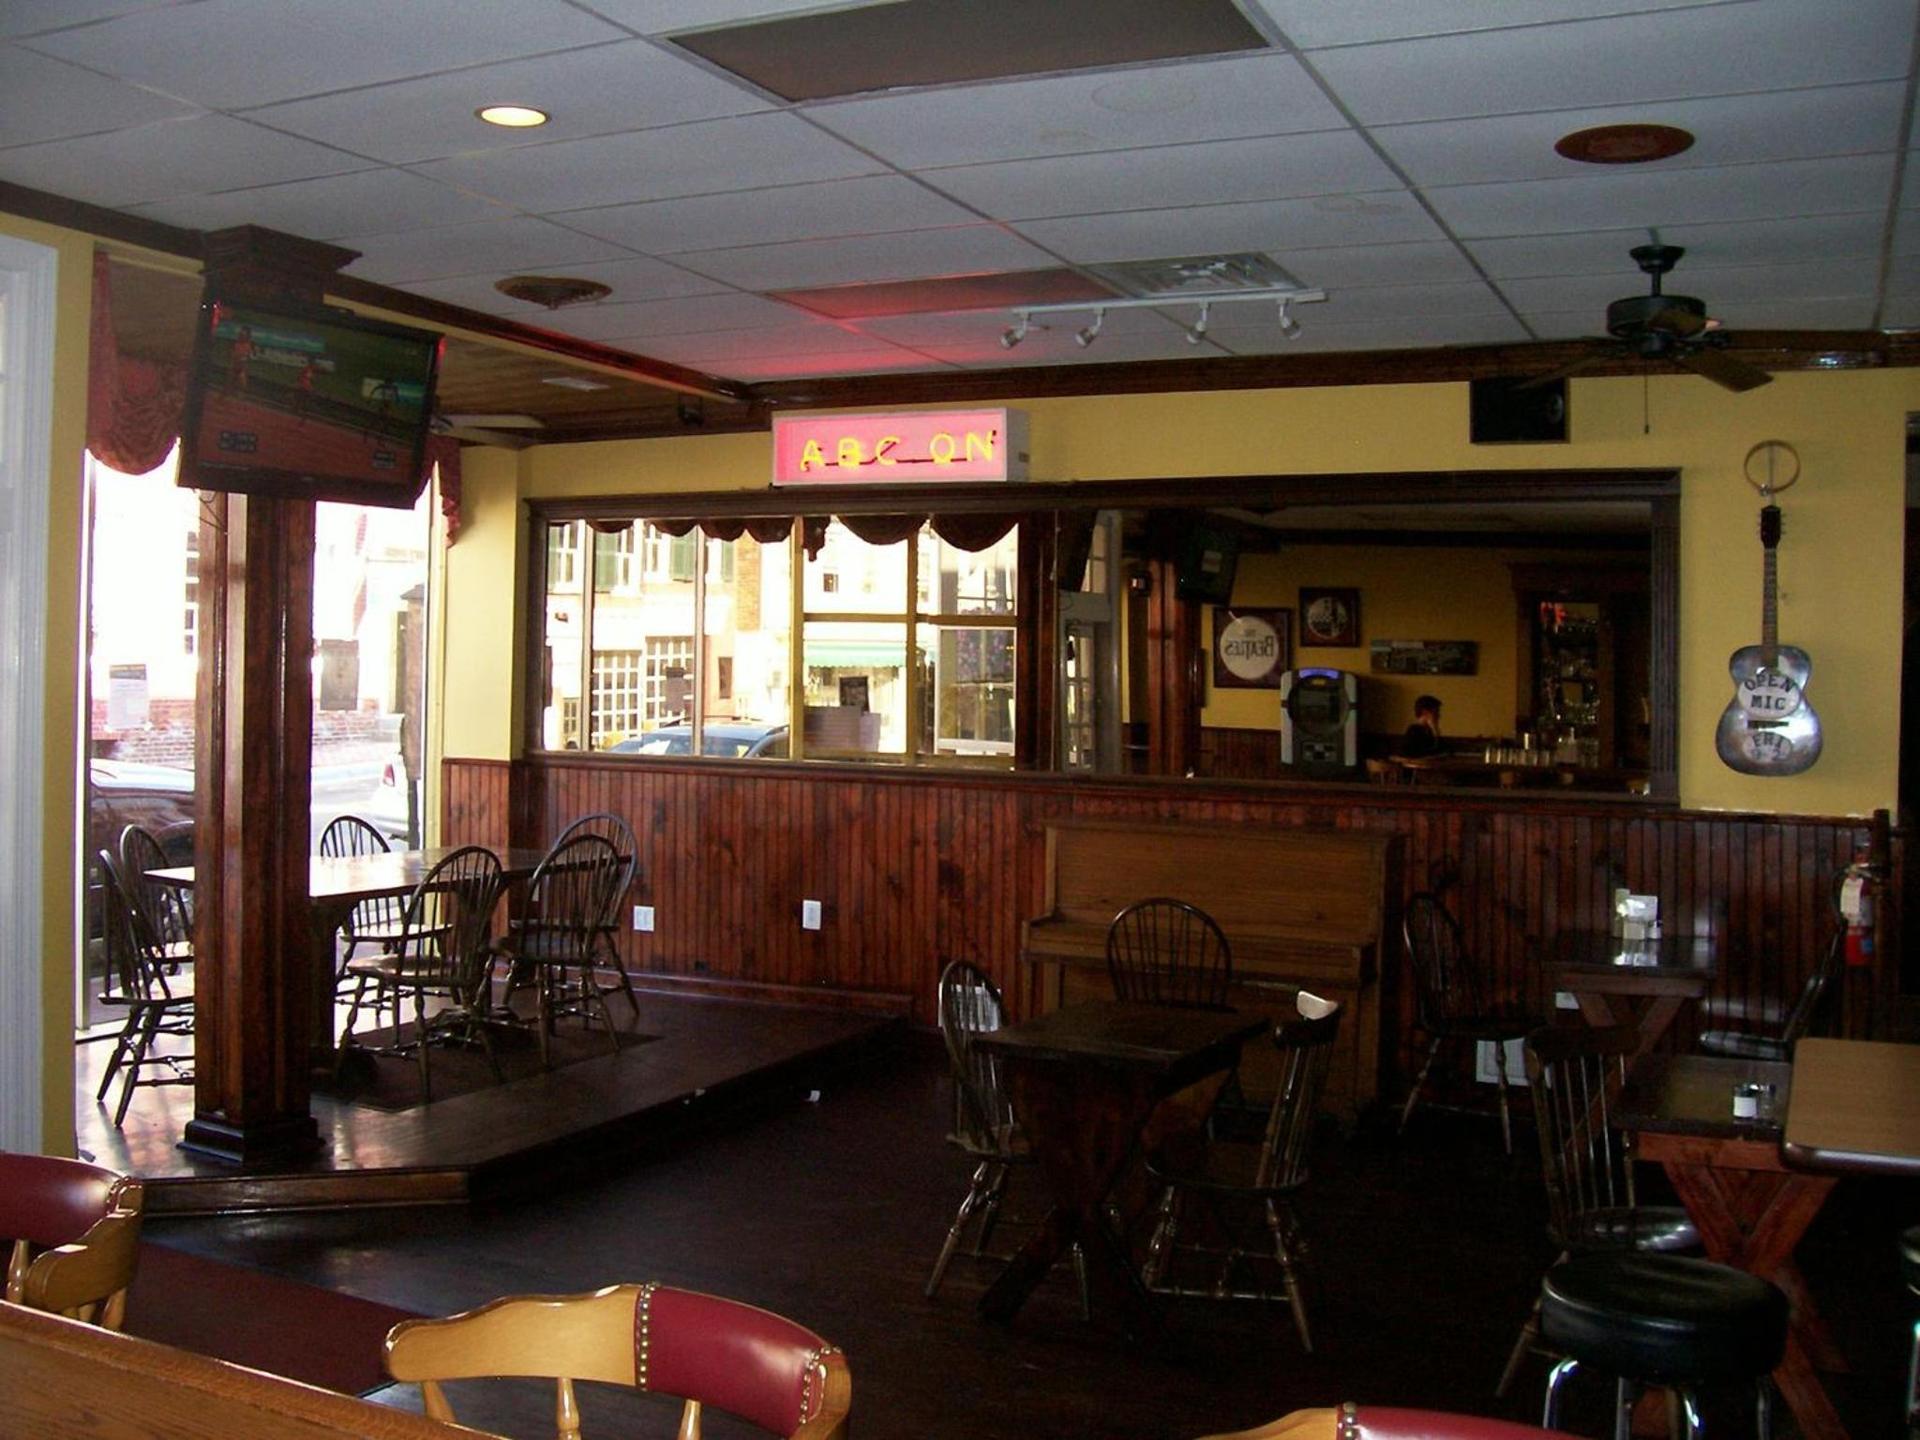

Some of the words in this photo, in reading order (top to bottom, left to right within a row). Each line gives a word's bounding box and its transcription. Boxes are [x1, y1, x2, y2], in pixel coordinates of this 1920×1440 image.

[929, 431, 994, 465] ON
[1744, 672, 1799, 693] OPEN
[1751, 694, 1786, 710] MIC
